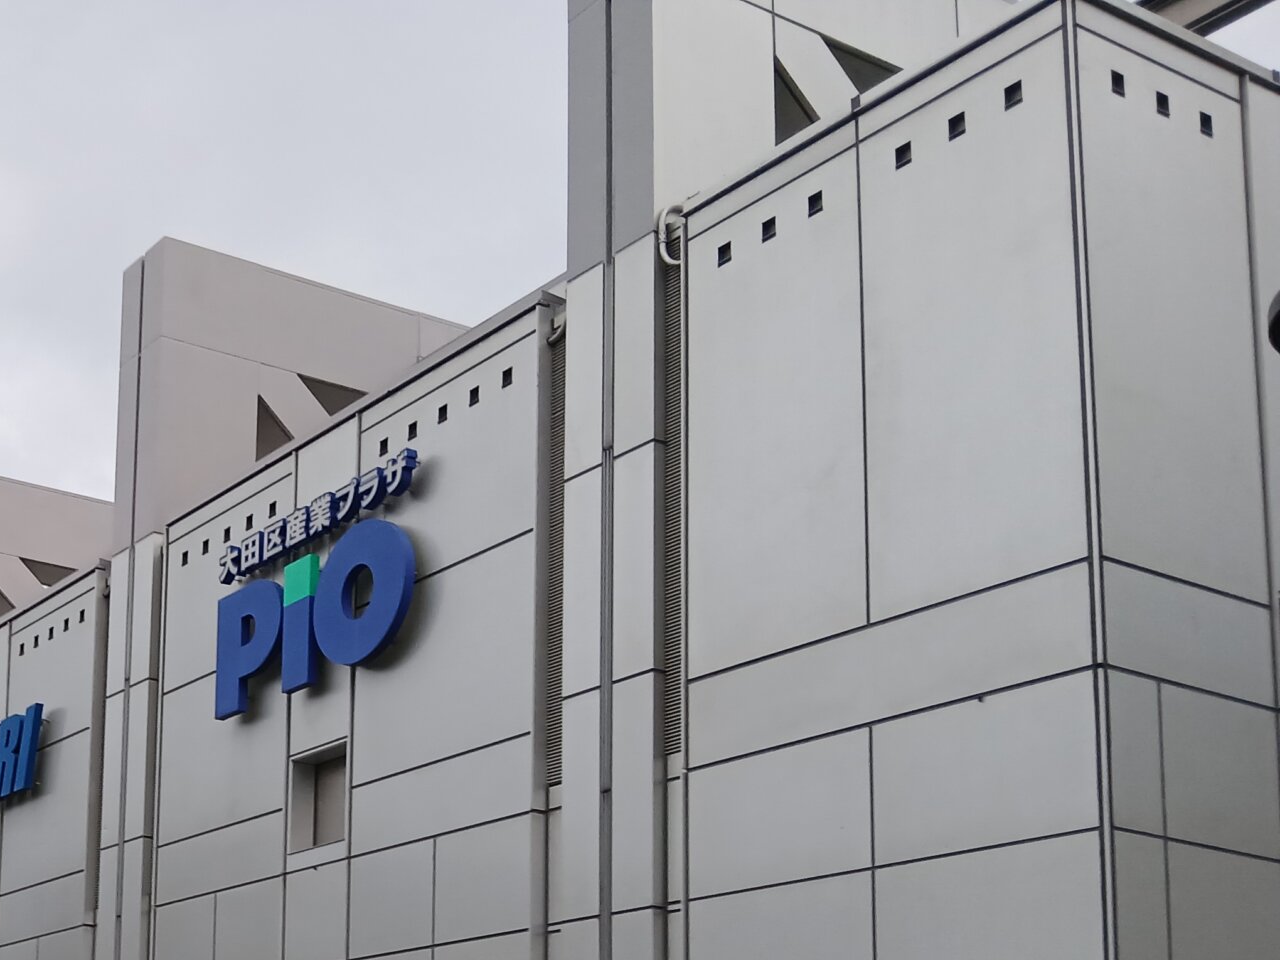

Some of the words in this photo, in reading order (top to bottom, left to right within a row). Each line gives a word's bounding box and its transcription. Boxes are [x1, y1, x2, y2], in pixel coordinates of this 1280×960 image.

[219, 448, 417, 584] 大田区産業プラザ
